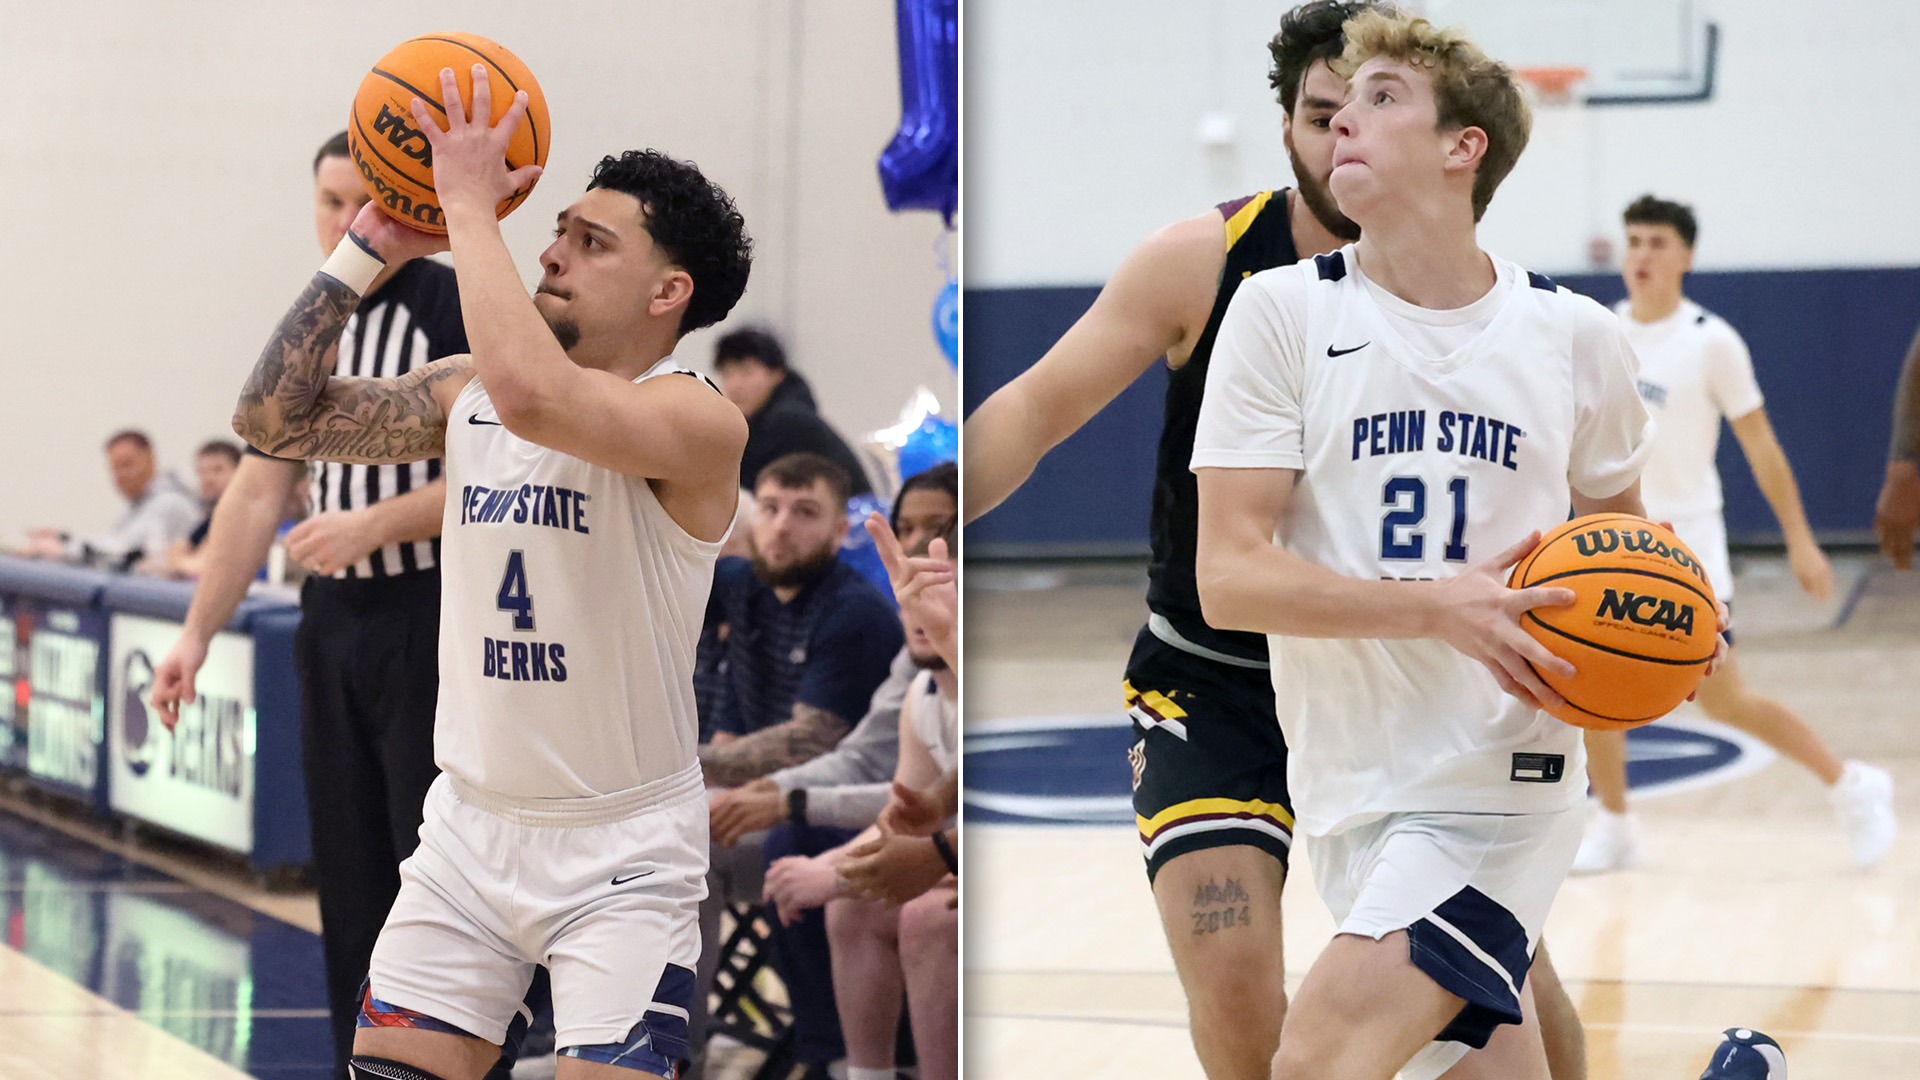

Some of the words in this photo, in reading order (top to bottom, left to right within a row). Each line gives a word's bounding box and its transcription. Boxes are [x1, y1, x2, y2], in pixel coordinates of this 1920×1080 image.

[1352, 410, 1426, 461] PENN
[1437, 410, 1523, 471] STATE
[461, 485, 519, 526] PENN
[513, 483, 590, 535] STATE
[1378, 474, 1470, 563] 21
[1571, 528, 1708, 586] Wilson
[495, 549, 537, 632] 4
[1595, 588, 1695, 637] NCAA
[483, 637, 568, 682] BERKS
[1550, 763, 1556, 775] L
[1190, 906, 1251, 935] 2004
